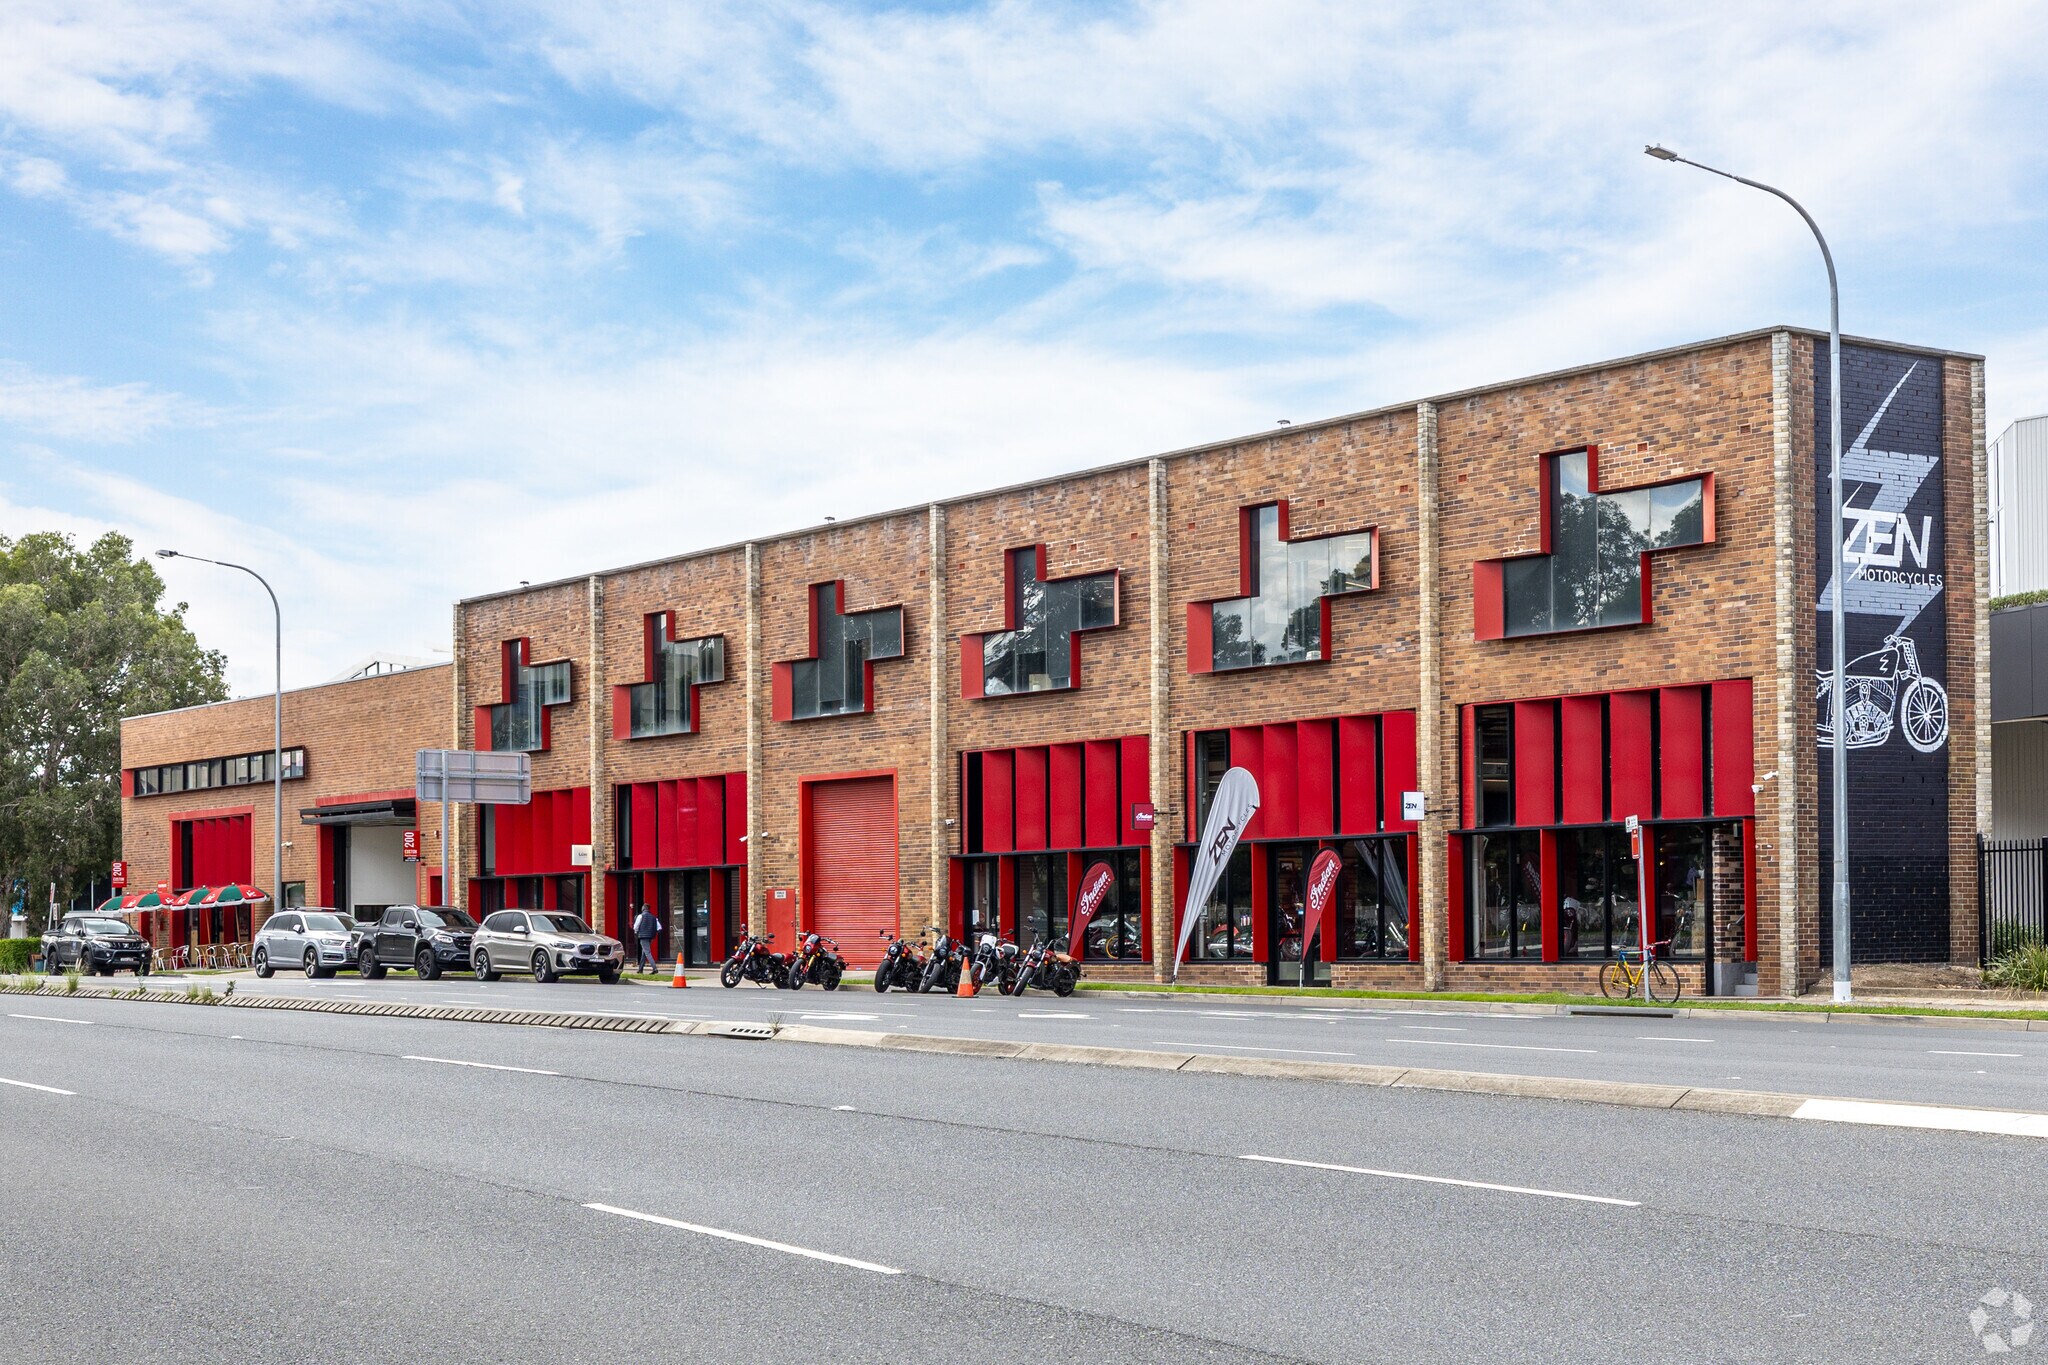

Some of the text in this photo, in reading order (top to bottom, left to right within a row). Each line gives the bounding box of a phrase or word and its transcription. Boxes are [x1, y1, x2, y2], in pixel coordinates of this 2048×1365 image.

[1842, 483, 1932, 569] ZEN
[1858, 568, 1943, 587] MOTORCYCLES
[404, 832, 415, 848] 200
[1208, 816, 1236, 866] ZEN
[112, 862, 122, 876] 200
[1310, 858, 1336, 909] Indian
[1081, 871, 1110, 915] Indian
